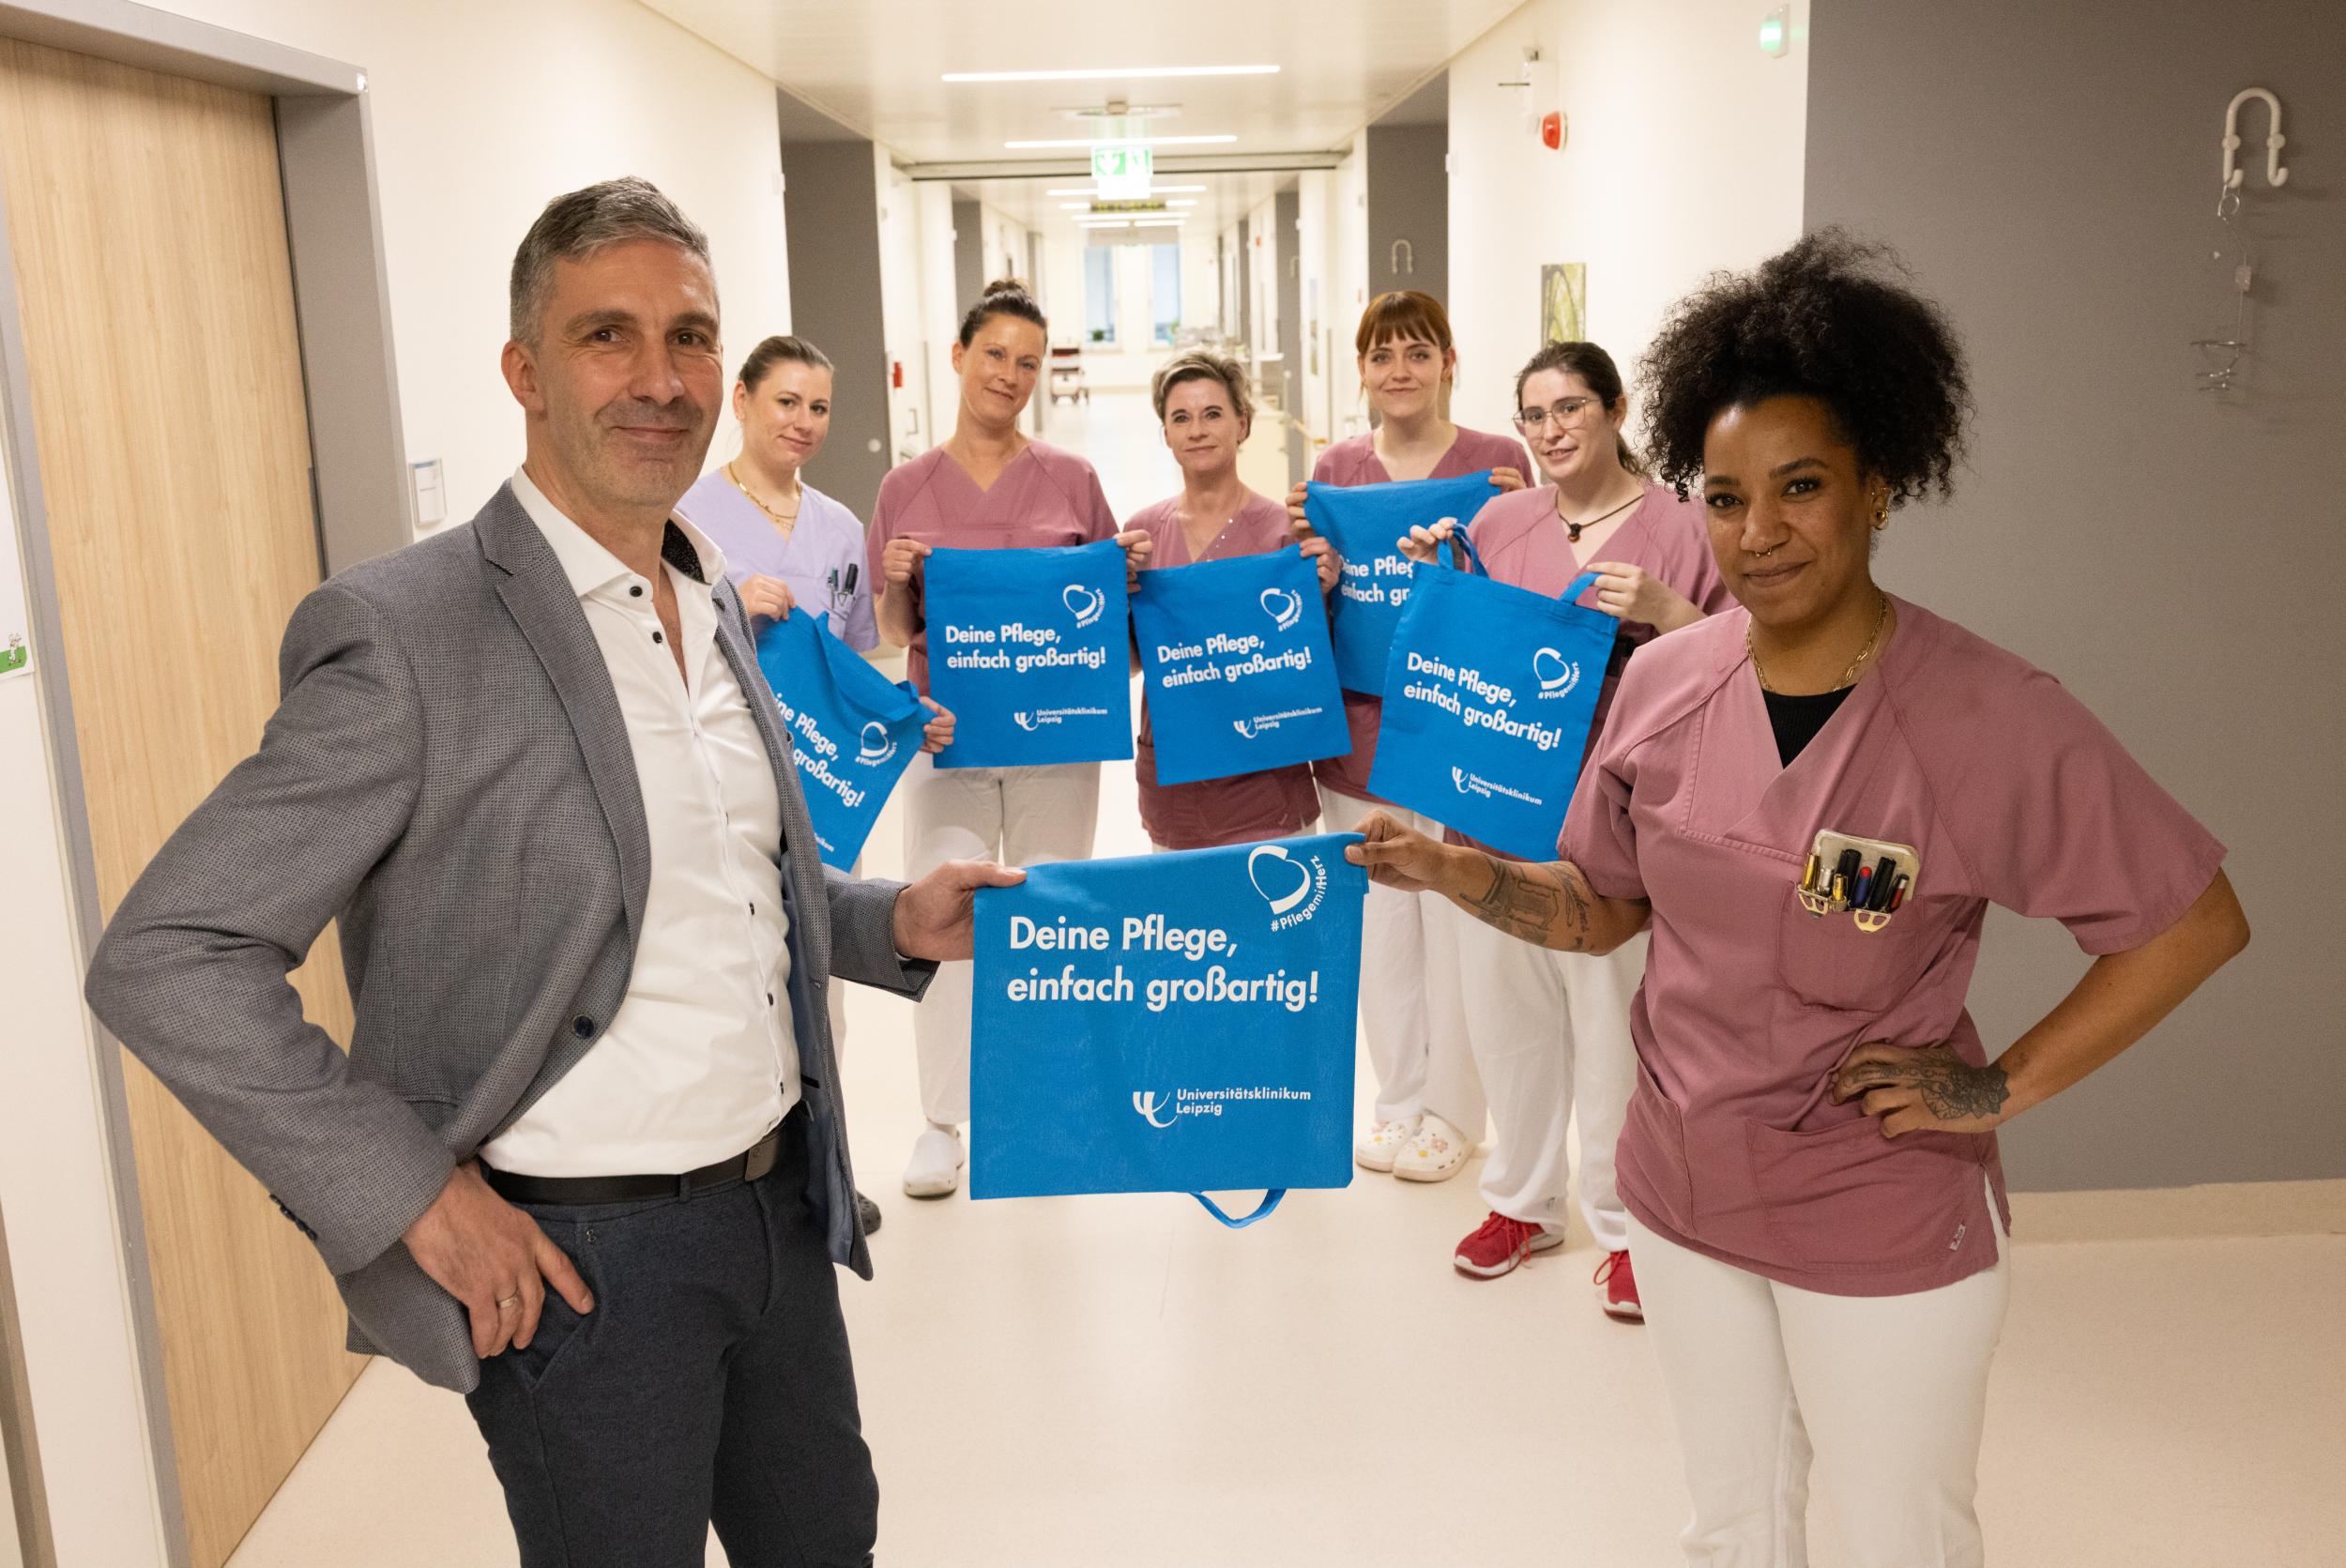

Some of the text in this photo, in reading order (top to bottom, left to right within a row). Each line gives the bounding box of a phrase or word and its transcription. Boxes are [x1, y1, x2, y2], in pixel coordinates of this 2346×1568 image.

[946, 623, 1060, 646] Deine Pflege,
[1158, 634, 1264, 662] Deine Pflege,
[947, 647, 1105, 673] einfach großartig!
[1163, 647, 1311, 687] einfach großartig!
[1408, 652, 1516, 707] Deine Pflege,
[795, 713, 839, 761] Pflege,
[1404, 683, 1561, 751] einfach großartig!
[793, 749, 865, 807] großartig!
[1468, 781, 1490, 798] Leipzig
[1271, 855, 1328, 932] #PflegemitHerz
[1011, 914, 1237, 961] Deine Pflege,
[1008, 965, 1318, 1012] einfach großartig!
[1177, 1102, 1222, 1116] Leipzig
[1178, 1087, 1310, 1101] Universitätsklinikum
